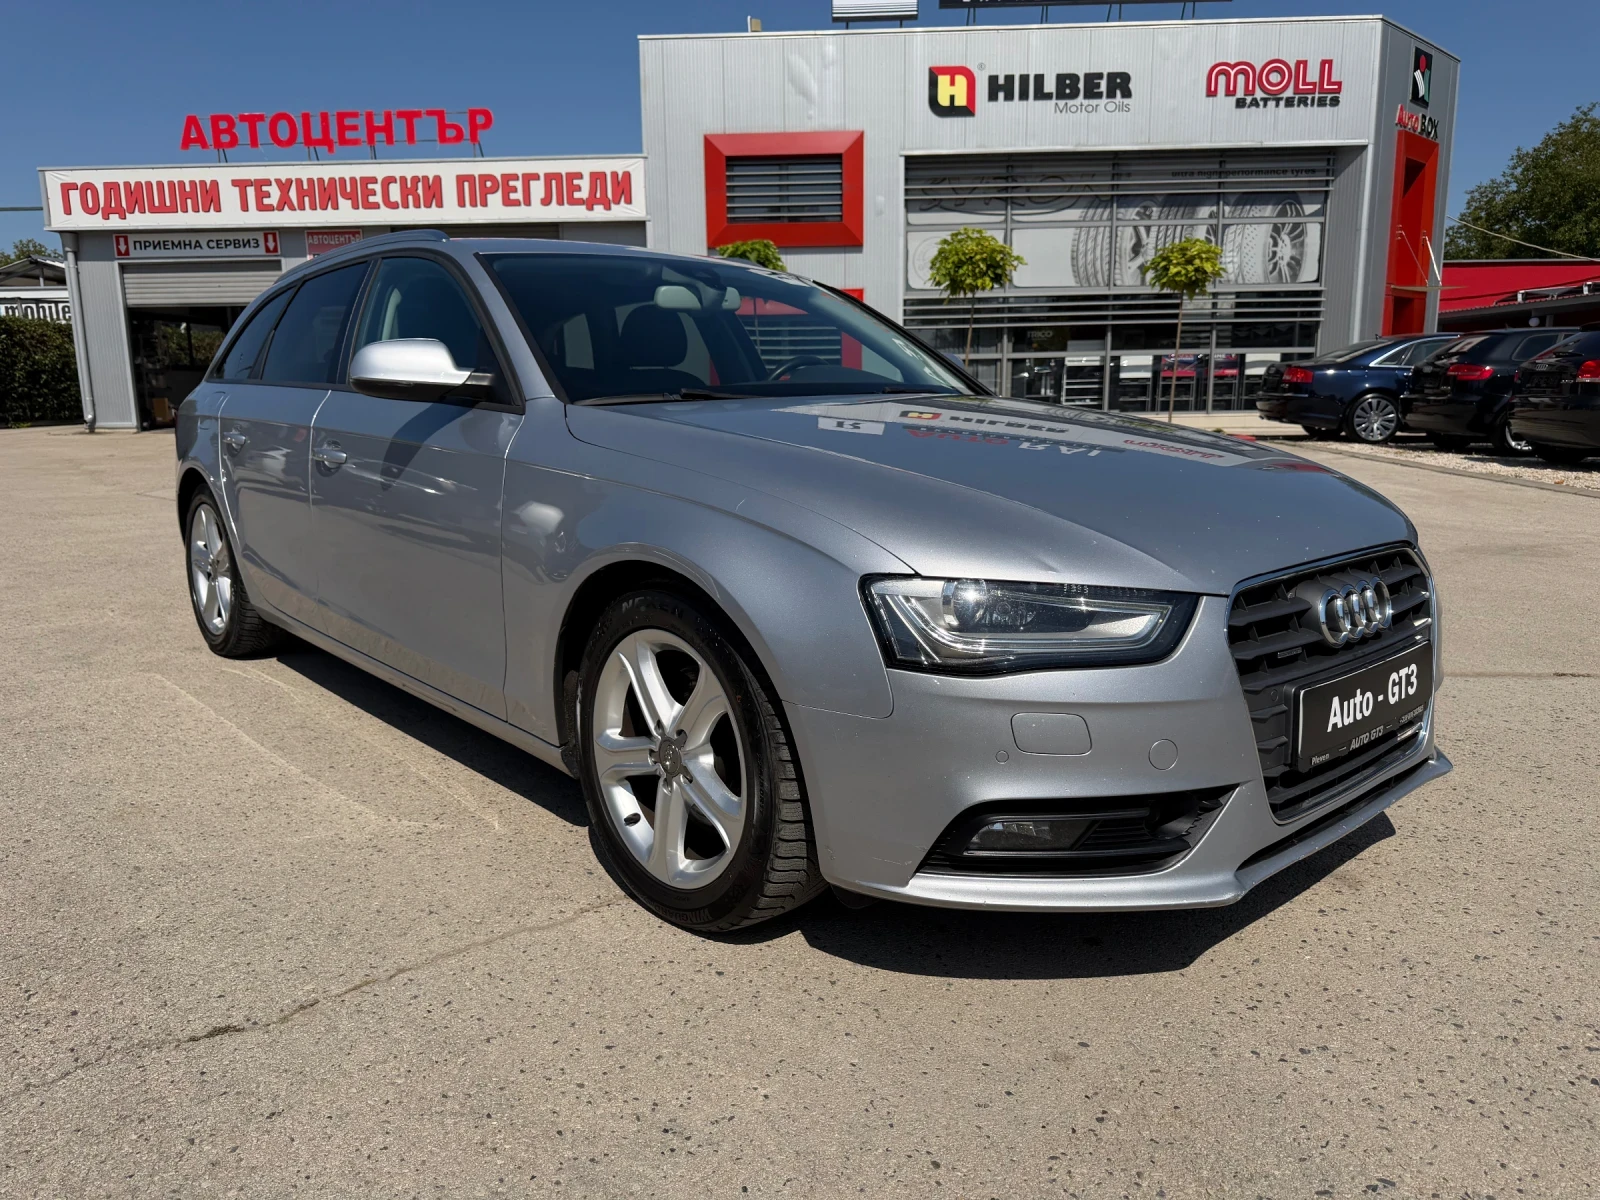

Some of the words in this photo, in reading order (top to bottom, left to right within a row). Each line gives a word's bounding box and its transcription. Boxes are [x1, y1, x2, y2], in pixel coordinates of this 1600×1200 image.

[987, 72, 1133, 102] HILBER
[1206, 58, 1343, 97] MOLL
[1054, 102, 1100, 114] Motor
[1104, 100, 1131, 113] Oils
[1235, 96, 1341, 109] BATTERIES
[180, 108, 494, 154] АВТОЦЕНТЪР
[60, 179, 222, 220] ГОДИШНИ
[231, 174, 444, 213] ТЕХНИЧЕСКИ
[456, 171, 633, 211] ПРЕГЛЕДИ
[133, 239, 204, 251] ПРИЕМНА
[206, 238, 260, 250] СЕРВИЗ
[308, 233, 361, 245] АВТОЦЕНТЪР
[1327, 688, 1373, 732] Auto
[1388, 663, 1418, 705] GT3
[1350, 733, 1370, 751] AUTO
[1370, 725, 1384, 740] GT3
[1311, 753, 1330, 766] Pleven
